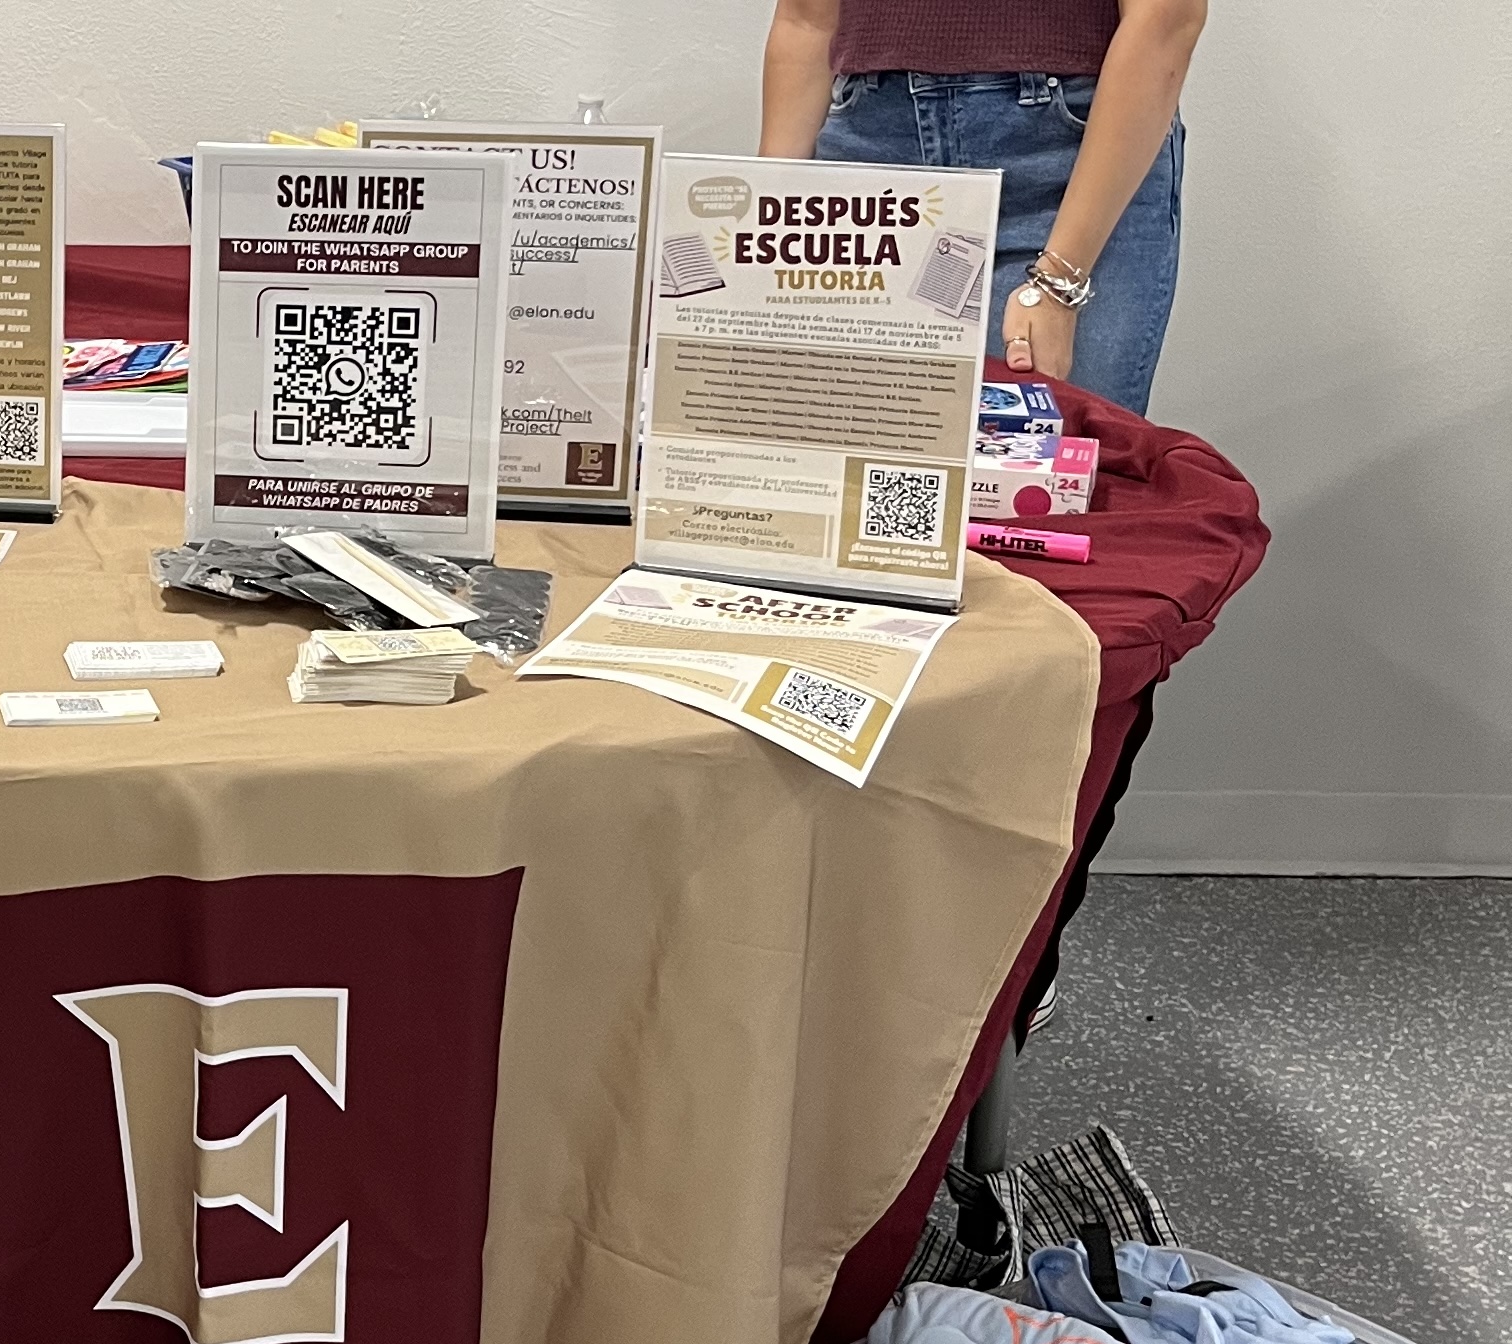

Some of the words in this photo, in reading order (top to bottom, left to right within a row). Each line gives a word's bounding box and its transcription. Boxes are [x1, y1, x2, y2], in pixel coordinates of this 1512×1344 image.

[22, 150, 46, 158] Village
[531, 149, 576, 170] US!
[277, 175, 347, 208] SCAN
[358, 176, 424, 210] HERE
[515, 175, 635, 195] ÁCTENOS!
[513, 199, 534, 209] NTS,
[540, 200, 555, 209] OR
[559, 201, 624, 210] CONCERNS:
[758, 188, 920, 227] DESPUÉS
[288, 213, 369, 233] ESCANEAR
[372, 211, 411, 235] AQUÍ
[7, 243, 40, 252] GRAHAM
[512, 229, 636, 249] /u/academics/
[232, 240, 251, 253] TO
[255, 242, 287, 255] JOIN
[292, 242, 320, 255] THE
[325, 243, 409, 256] WHATSAPP
[414, 245, 468, 258] GROUP
[735, 232, 901, 266] ESCUELA
[7, 260, 40, 268] GRAHAM
[297, 259, 326, 271] FOR
[331, 260, 399, 273] PARENTS
[774, 265, 885, 290] TUTORÍA
[766, 296, 790, 305] PARA
[793, 296, 857, 305] ESTUDIANTES
[859, 297, 870, 305] DE
[509, 306, 595, 320] @elon.edu
[730, 310, 771, 319] gratuitas
[773, 312, 811, 321] después
[826, 316, 854, 324] clases
[928, 324, 964, 332] semana
[718, 318, 769, 327] septiembre
[772, 321, 795, 329] hasta
[809, 325, 844, 333] semana
[889, 330, 939, 339] noviembre
[943, 333, 953, 341] de
[746, 328, 759, 336] las
[811, 334, 850, 343] escuelas
[852, 337, 897, 346] asociadas
[900, 339, 910, 347] de
[504, 360, 524, 374] 92
[1035, 424, 1054, 434] 24
[248, 479, 283, 492] PARA
[288, 481, 338, 493] UNIRSE
[341, 483, 357, 494] AL
[362, 484, 412, 497] GRUPO
[416, 486, 434, 498] DE
[1058, 478, 1080, 490] 24
[263, 494, 339, 508] WHATSAPP
[343, 498, 360, 509] DE
[364, 500, 419, 512] PADRES
[692, 504, 773, 522] ¿Preguntas?
[682, 519, 717, 531] Correo
[980, 534, 1048, 552] HI-LITER
[692, 598, 850, 622] SCHOOL
[738, 595, 857, 614] AFTER
[716, 611, 845, 626] TUTORING
